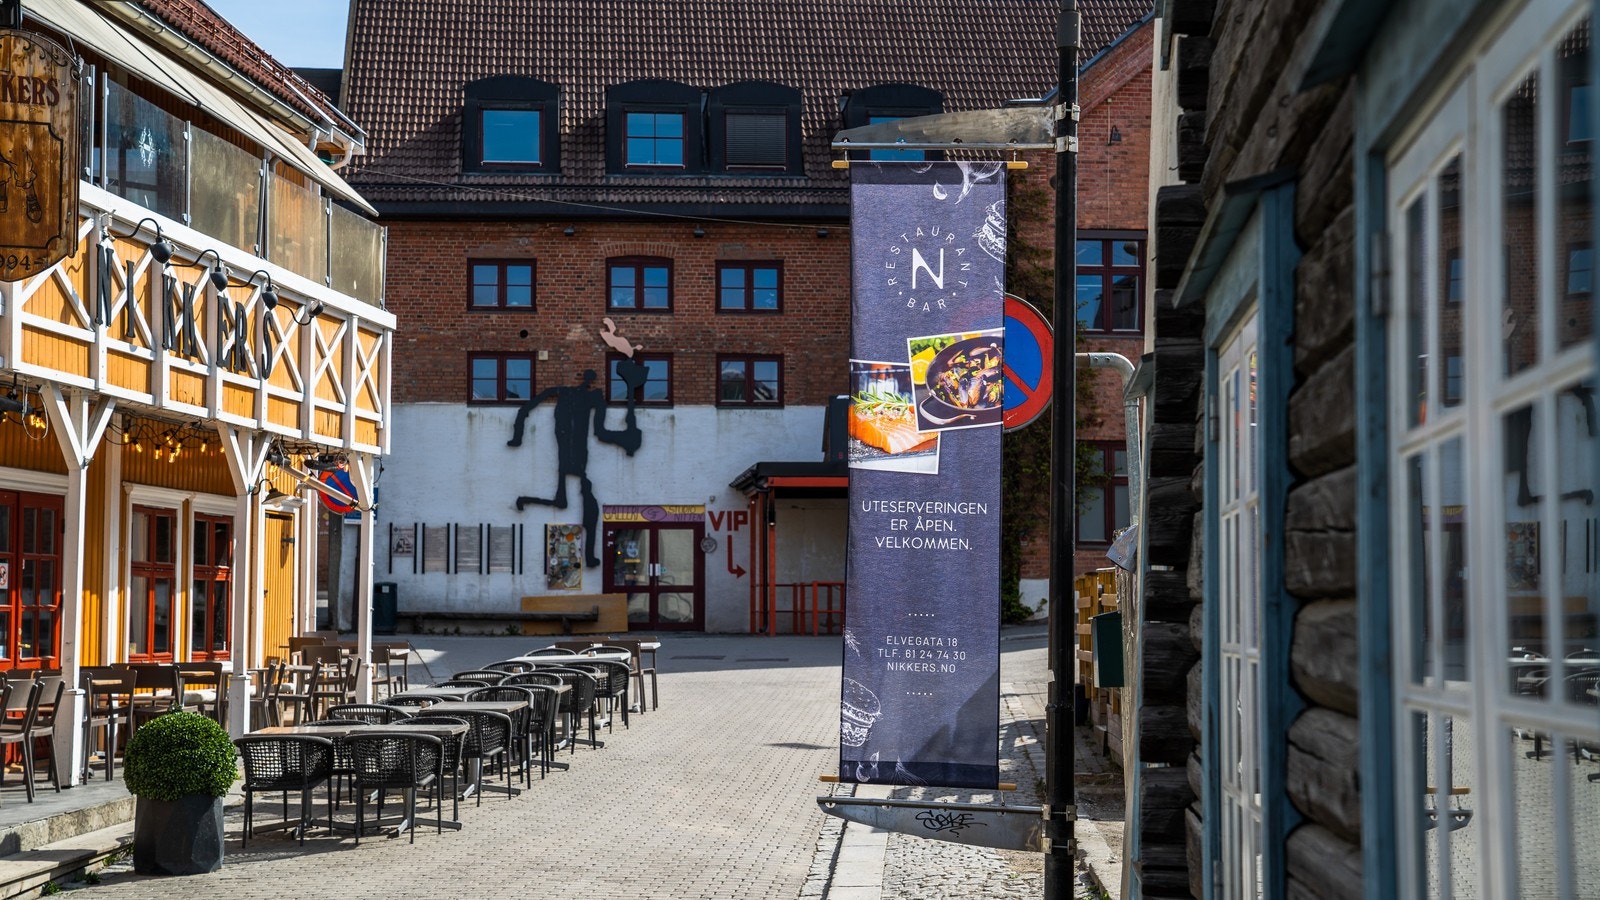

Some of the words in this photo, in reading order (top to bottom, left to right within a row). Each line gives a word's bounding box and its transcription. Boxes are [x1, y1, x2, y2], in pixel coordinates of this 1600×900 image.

[885, 226, 971, 288] RESTAURANT
[912, 247, 944, 290] N
[95, 243, 273, 380] NIKKERS
[907, 297, 946, 312] BAR
[862, 501, 988, 515] UTESERVERINGEN
[708, 510, 748, 532] VIP
[890, 518, 908, 531] ER
[915, 515, 957, 532] ÅPEN.
[875, 536, 973, 550] VELKOMMEN.
[886, 635, 943, 647] ELVEGATA
[947, 637, 958, 647] 18
[877, 648, 901, 659] TLF.
[905, 649, 916, 659] 61
[919, 649, 933, 659] 24
[936, 650, 950, 660] 74
[953, 650, 966, 661] 30
[887, 662, 956, 673] NIKKERS.NO
